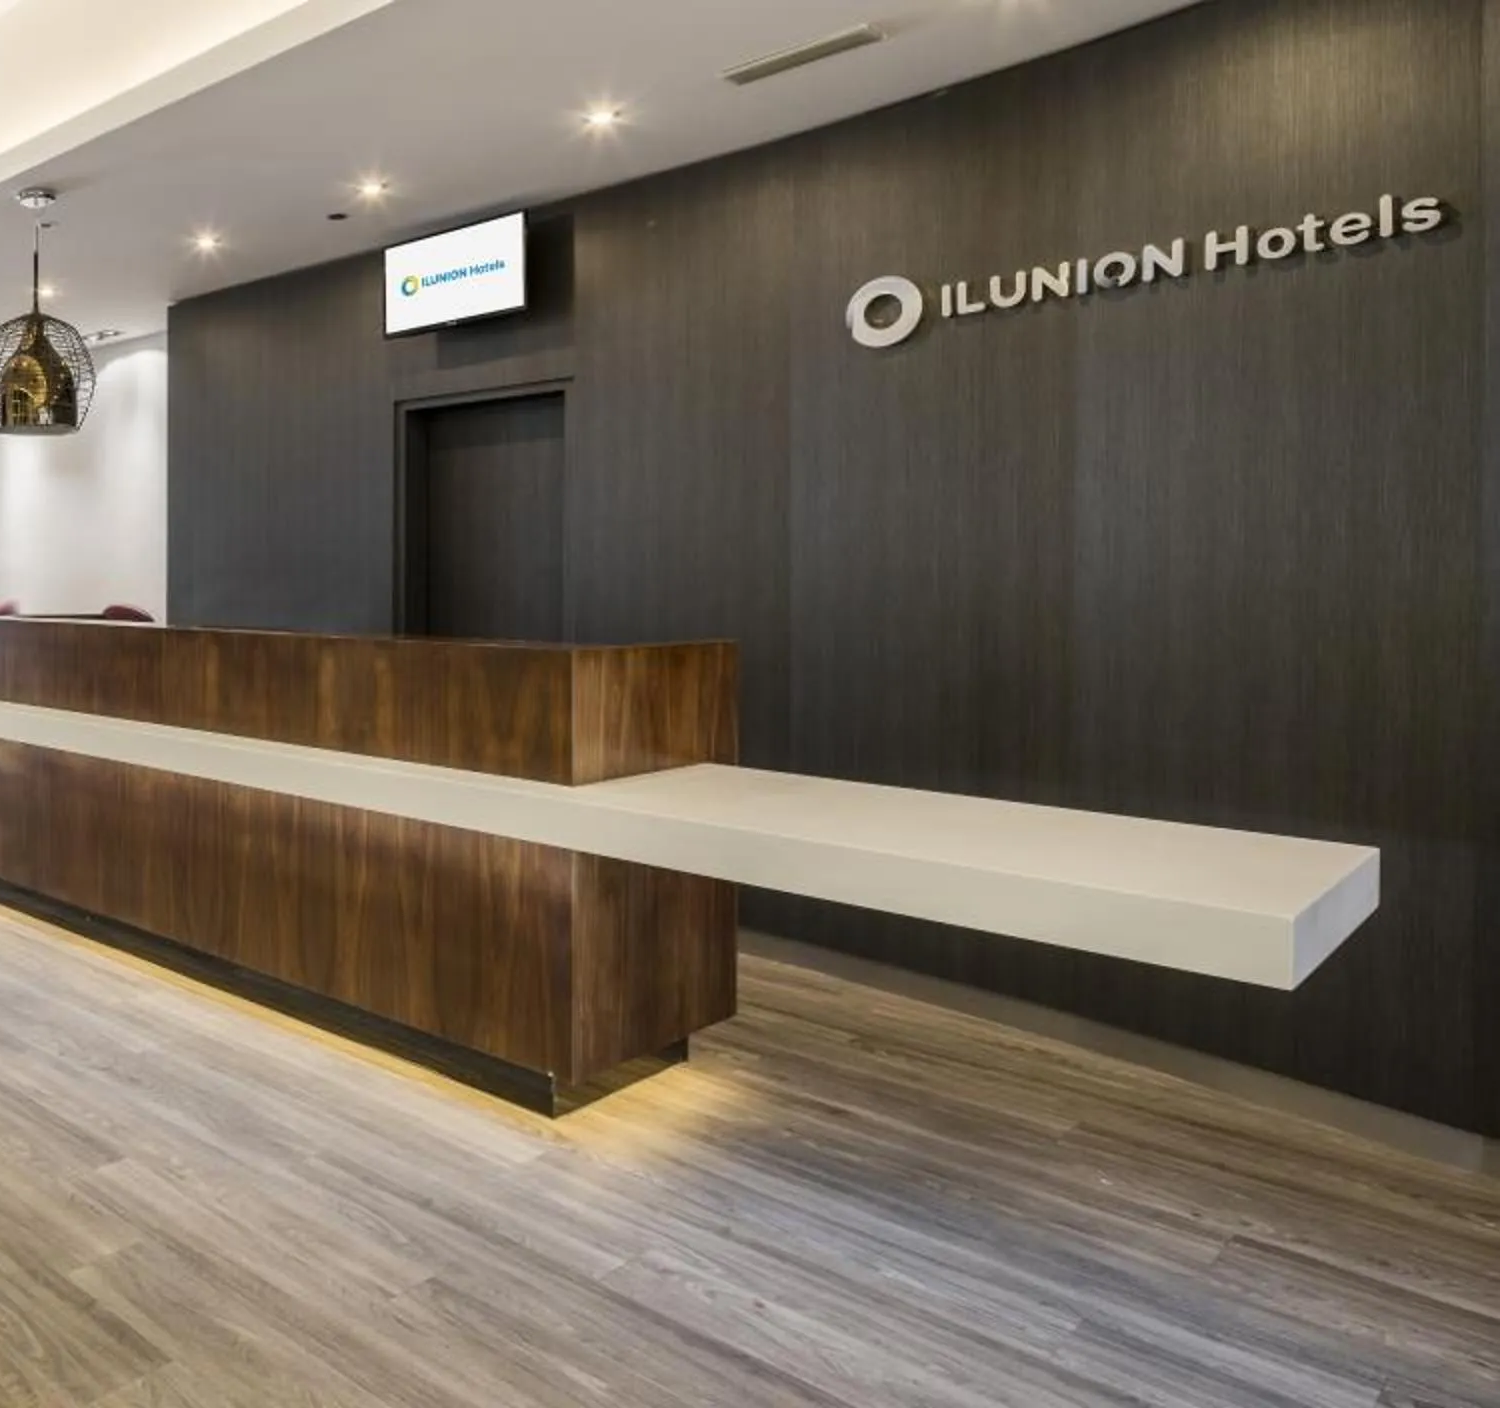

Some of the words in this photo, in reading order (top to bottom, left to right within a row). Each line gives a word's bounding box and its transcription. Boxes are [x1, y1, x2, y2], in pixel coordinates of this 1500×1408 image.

[421, 267, 467, 288] ILUNION
[469, 259, 505, 276] Hotels
[940, 237, 1185, 319] ILUNION
[1205, 194, 1442, 272] Hotels
